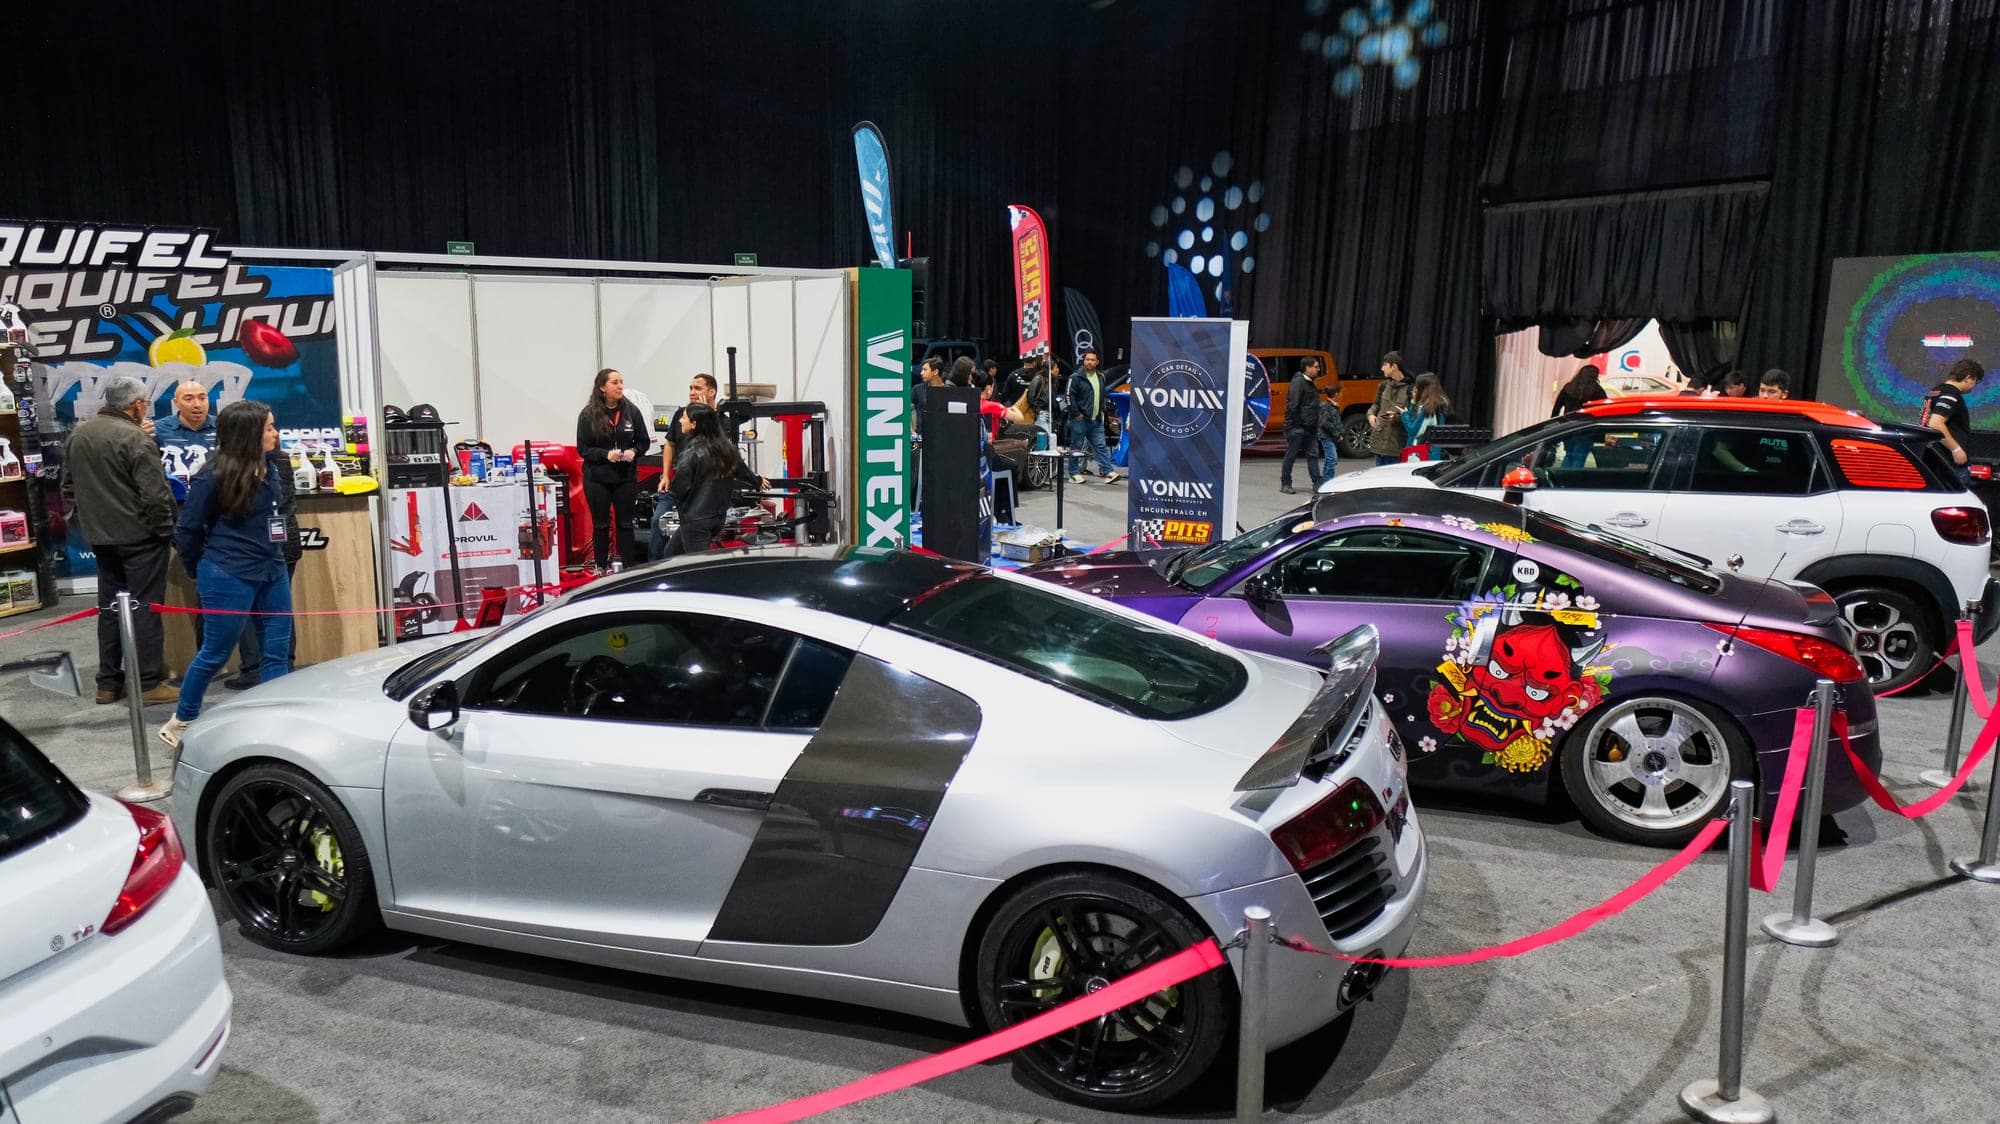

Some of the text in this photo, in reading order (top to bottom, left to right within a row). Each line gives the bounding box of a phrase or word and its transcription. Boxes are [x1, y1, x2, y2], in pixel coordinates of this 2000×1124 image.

[1161, 364, 1198, 375] CAR DETAIL
[1134, 387, 1225, 409] VONIXX
[1160, 424, 1195, 434] SCHOOL
[866, 329, 904, 548] VINTEX
[1139, 479, 1213, 499] VONIXX
[1140, 507, 1194, 516] ENCUENTRALO
[1165, 521, 1210, 538] PITS
